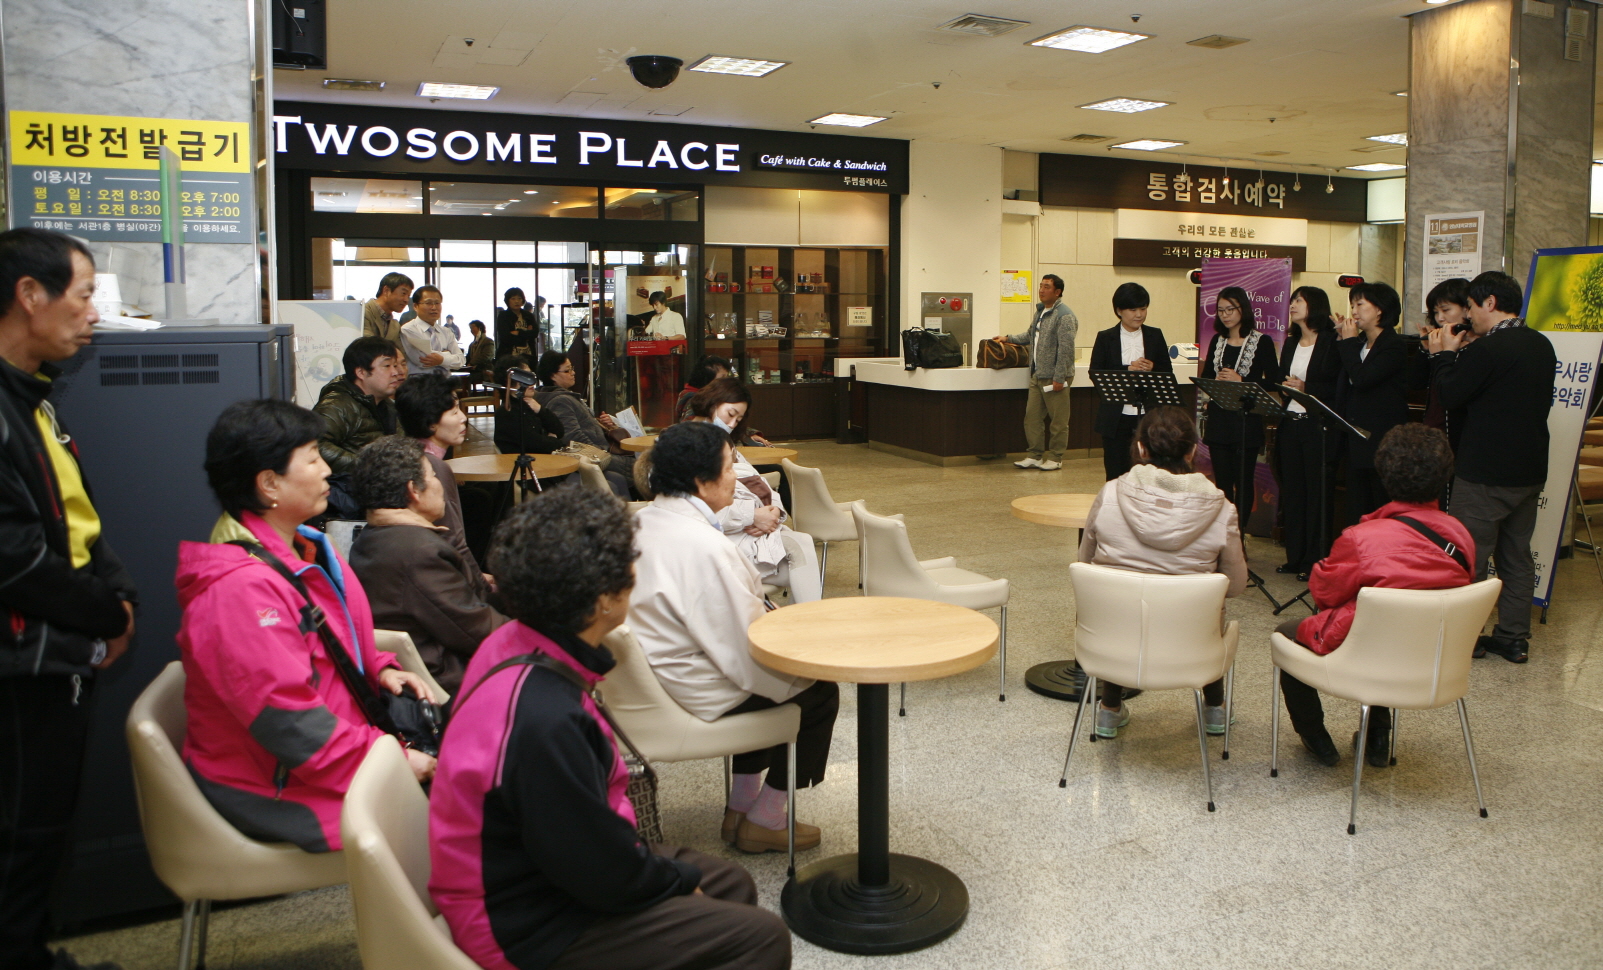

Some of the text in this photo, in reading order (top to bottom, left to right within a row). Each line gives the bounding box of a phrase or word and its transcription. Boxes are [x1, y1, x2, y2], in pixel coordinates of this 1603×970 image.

[25, 122, 239, 163] 처방전발급기
[272, 115, 740, 173] TWOSOME PLACE
[760, 154, 887, 171] Café with Cake & Sandwich
[33, 170, 93, 185] 이용시간
[97, 189, 125, 202] 오전
[130, 189, 161, 201] 8:30
[181, 191, 206, 204] 오후
[210, 192, 240, 203] 7:00
[1147, 172, 1286, 209] 통합검사예약
[34, 202, 82, 215] 토요일
[98, 203, 125, 216] 오전
[130, 204, 161, 215] 8:30
[182, 205, 207, 218] 오후
[211, 206, 240, 217] 2:00
[34, 220, 73, 231] 이후에는
[78, 221, 112, 231] 서관1층
[193, 224, 241, 233] 이용하세요.
[1177, 224, 1205, 236] 우리의
[1208, 226, 1226, 237] 모든
[1162, 246, 1190, 258] 고객의
[1246, 291, 1285, 304] Wave of
